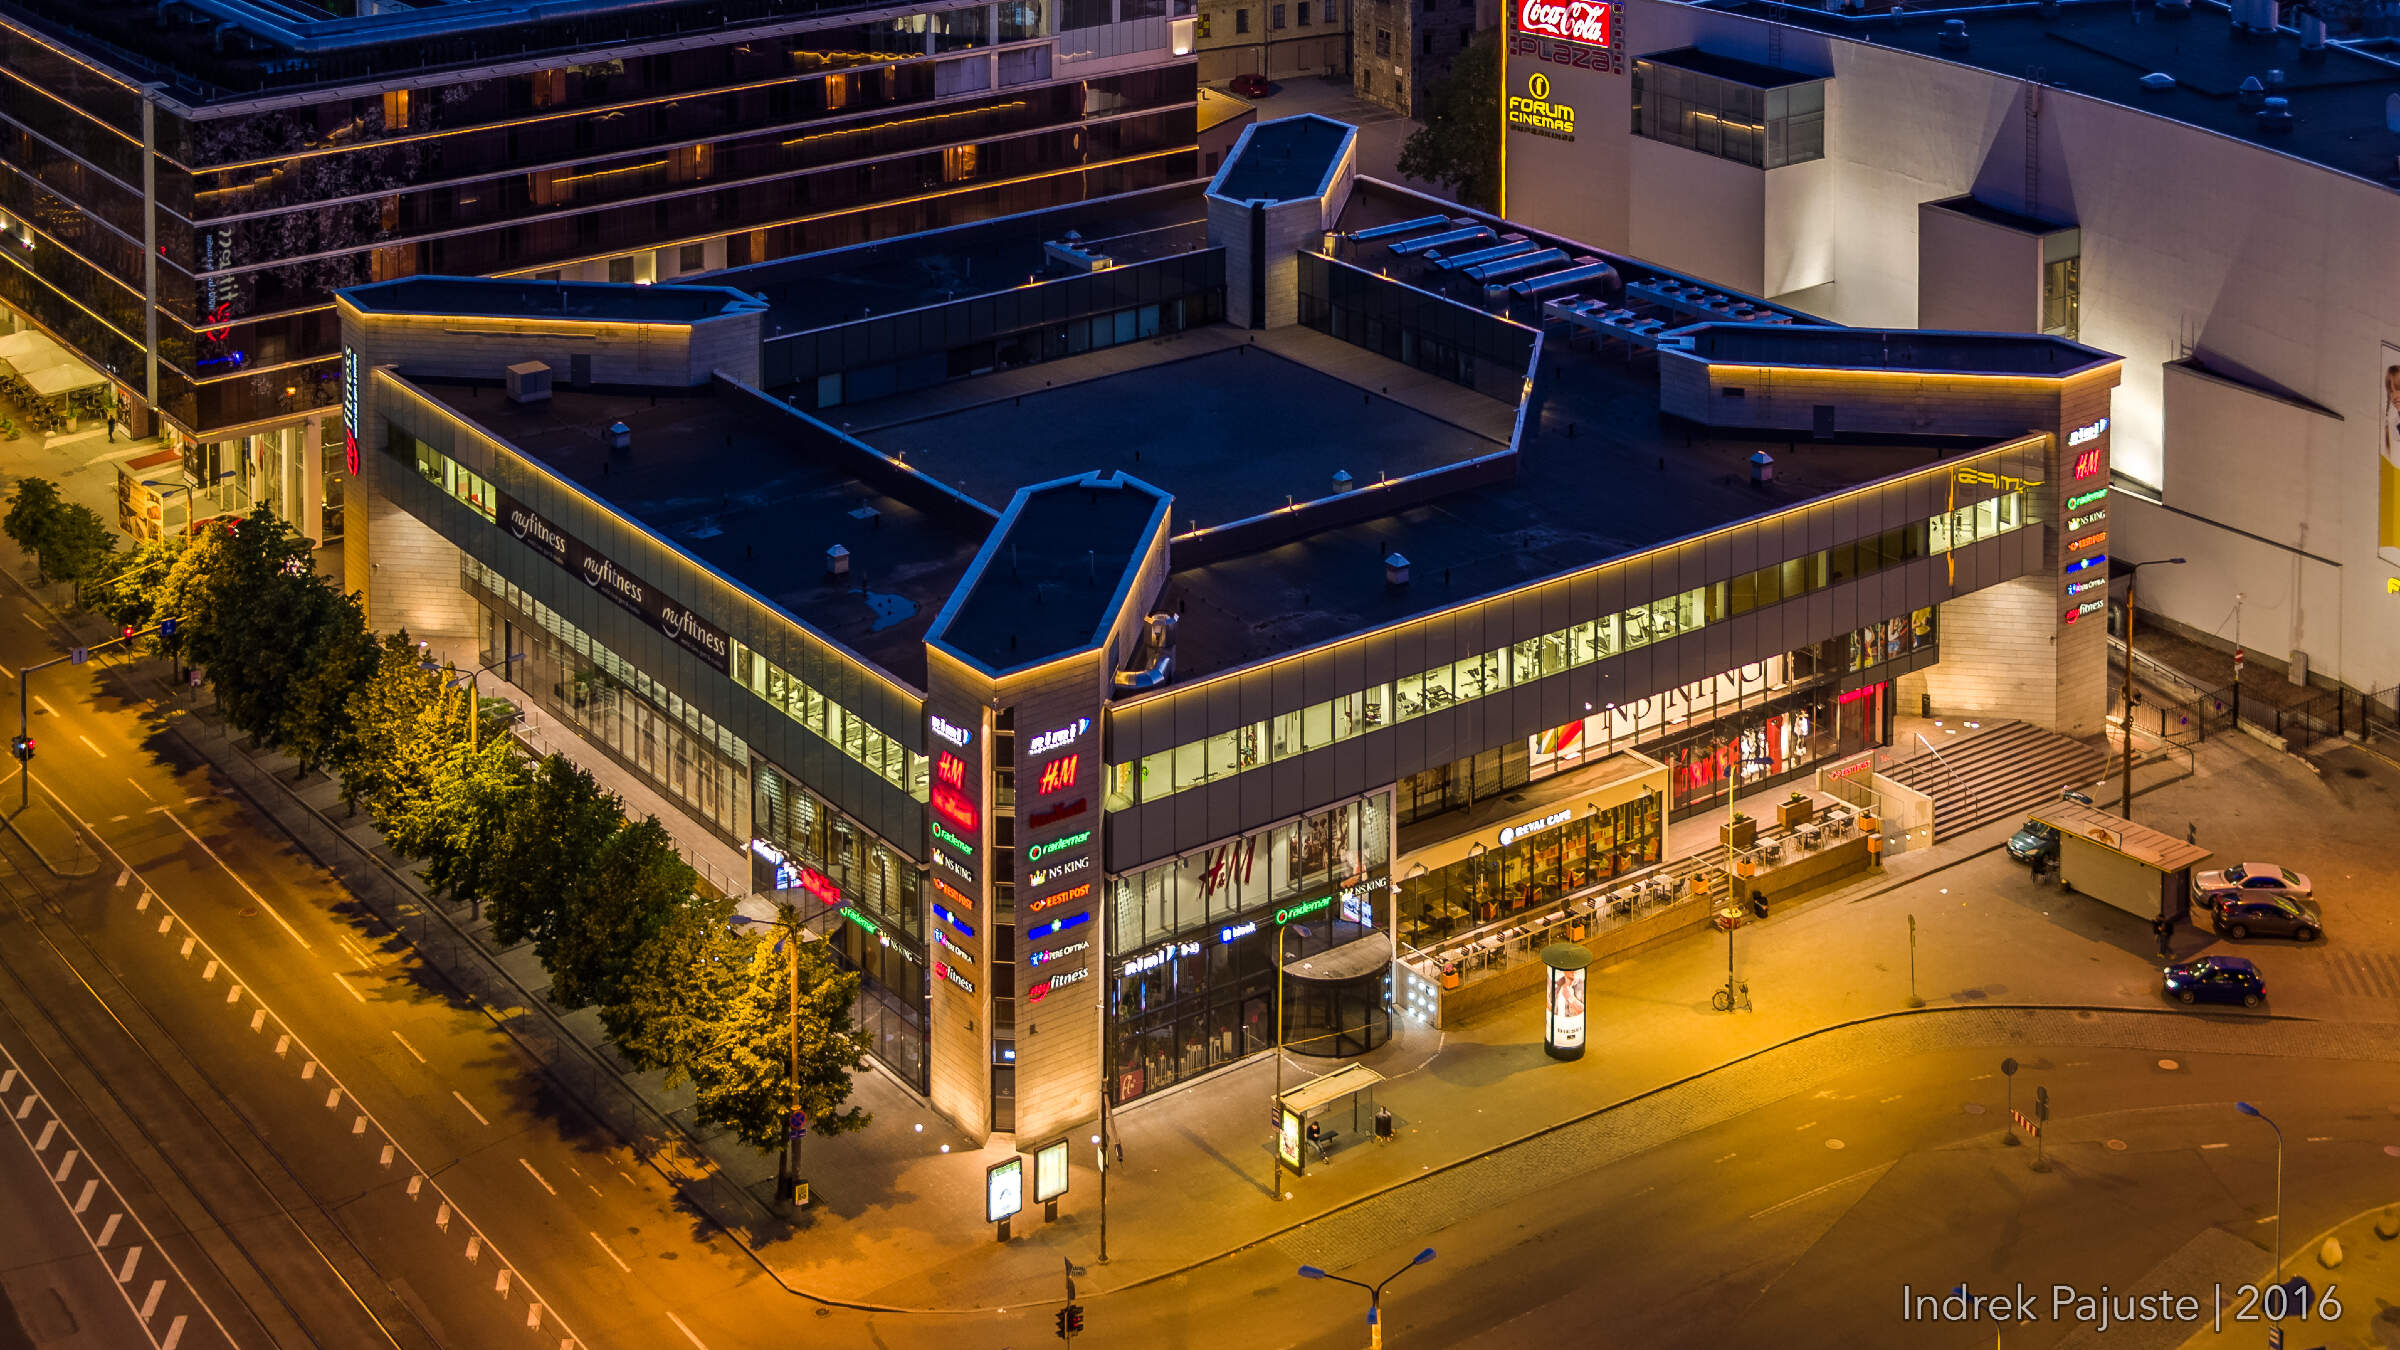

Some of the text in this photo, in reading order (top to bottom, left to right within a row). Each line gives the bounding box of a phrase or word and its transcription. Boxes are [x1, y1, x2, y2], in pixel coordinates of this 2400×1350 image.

[1509, 96, 1575, 122] FORUM
[1509, 111, 1574, 133] CINEMAS
[511, 509, 566, 553] myfitness
[584, 554, 643, 603] myfitness
[661, 606, 726, 657] myfitness
[941, 828, 973, 855] rademar
[1042, 830, 1091, 855] rademar
[955, 863, 972, 883] KING
[1049, 857, 1089, 879] NS KING
[1046, 883, 1091, 907] EESTI POST
[1366, 877, 1387, 892] KING
[1287, 896, 1332, 919] rademar
